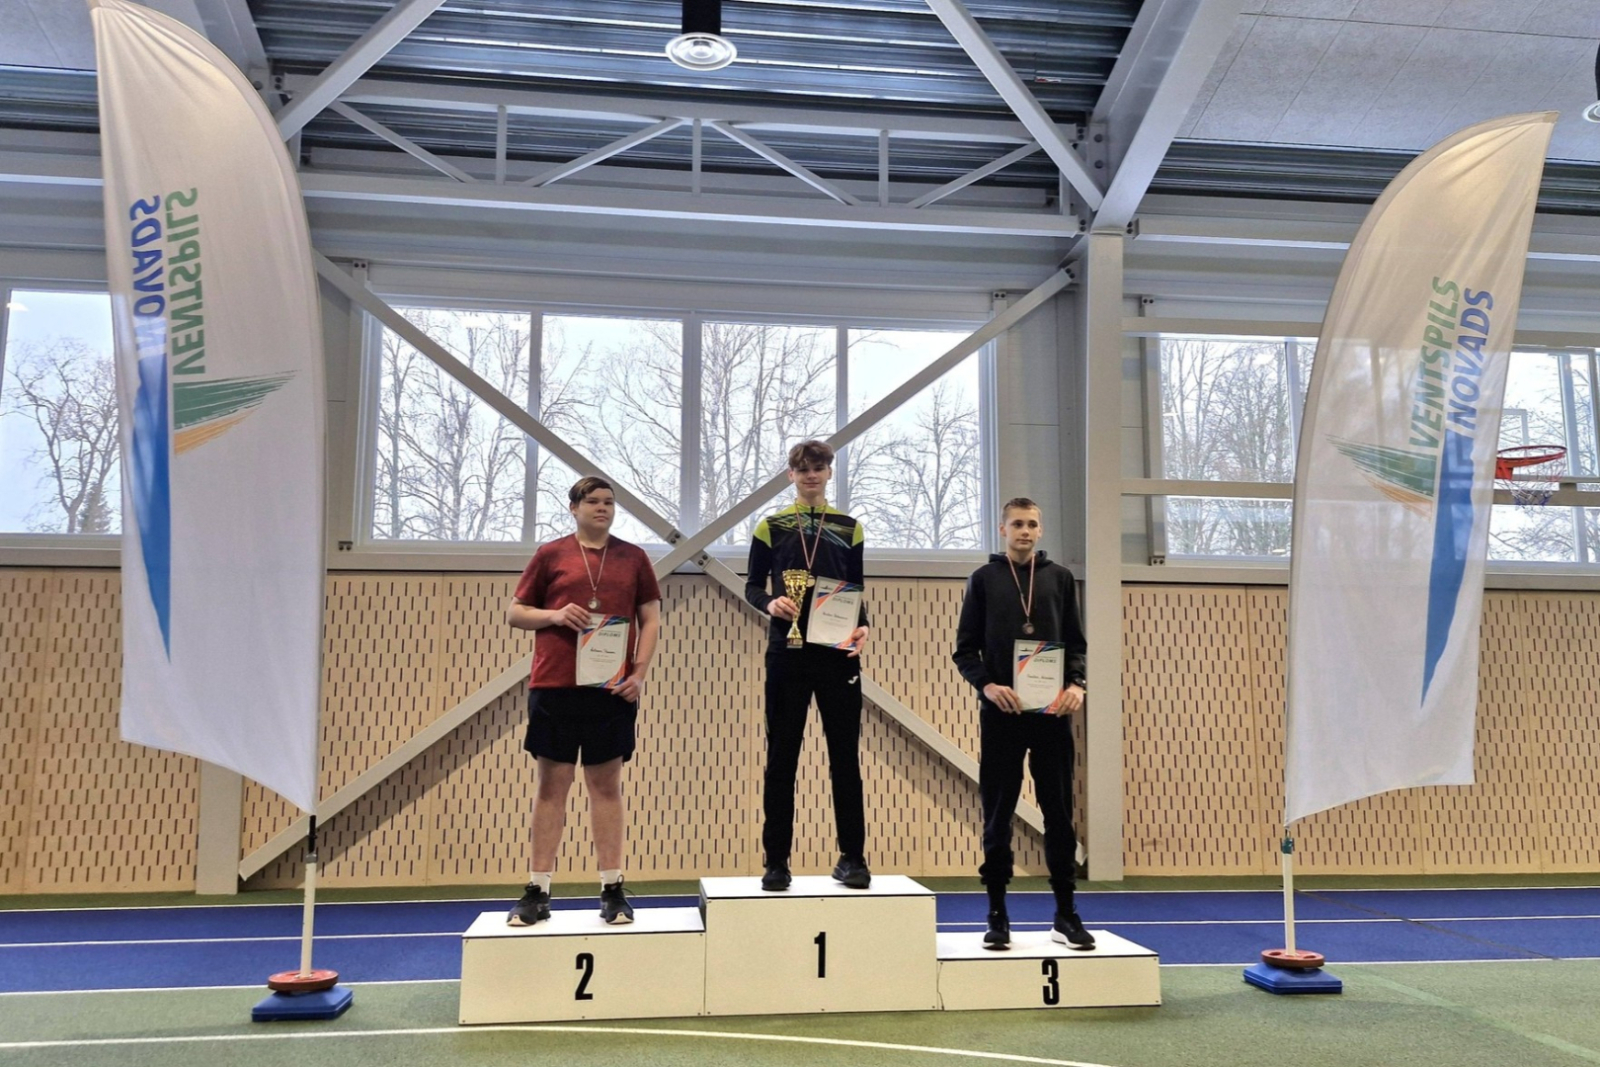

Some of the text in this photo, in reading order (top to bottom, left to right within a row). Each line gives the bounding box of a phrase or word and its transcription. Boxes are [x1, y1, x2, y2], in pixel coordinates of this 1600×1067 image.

[1409, 276, 1460, 448] VENTSPILS
[1447, 288, 1493, 432] NOVADS
[575, 952, 594, 1000] 2
[814, 931, 826, 978] 1
[1041, 958, 1060, 1005] 3
